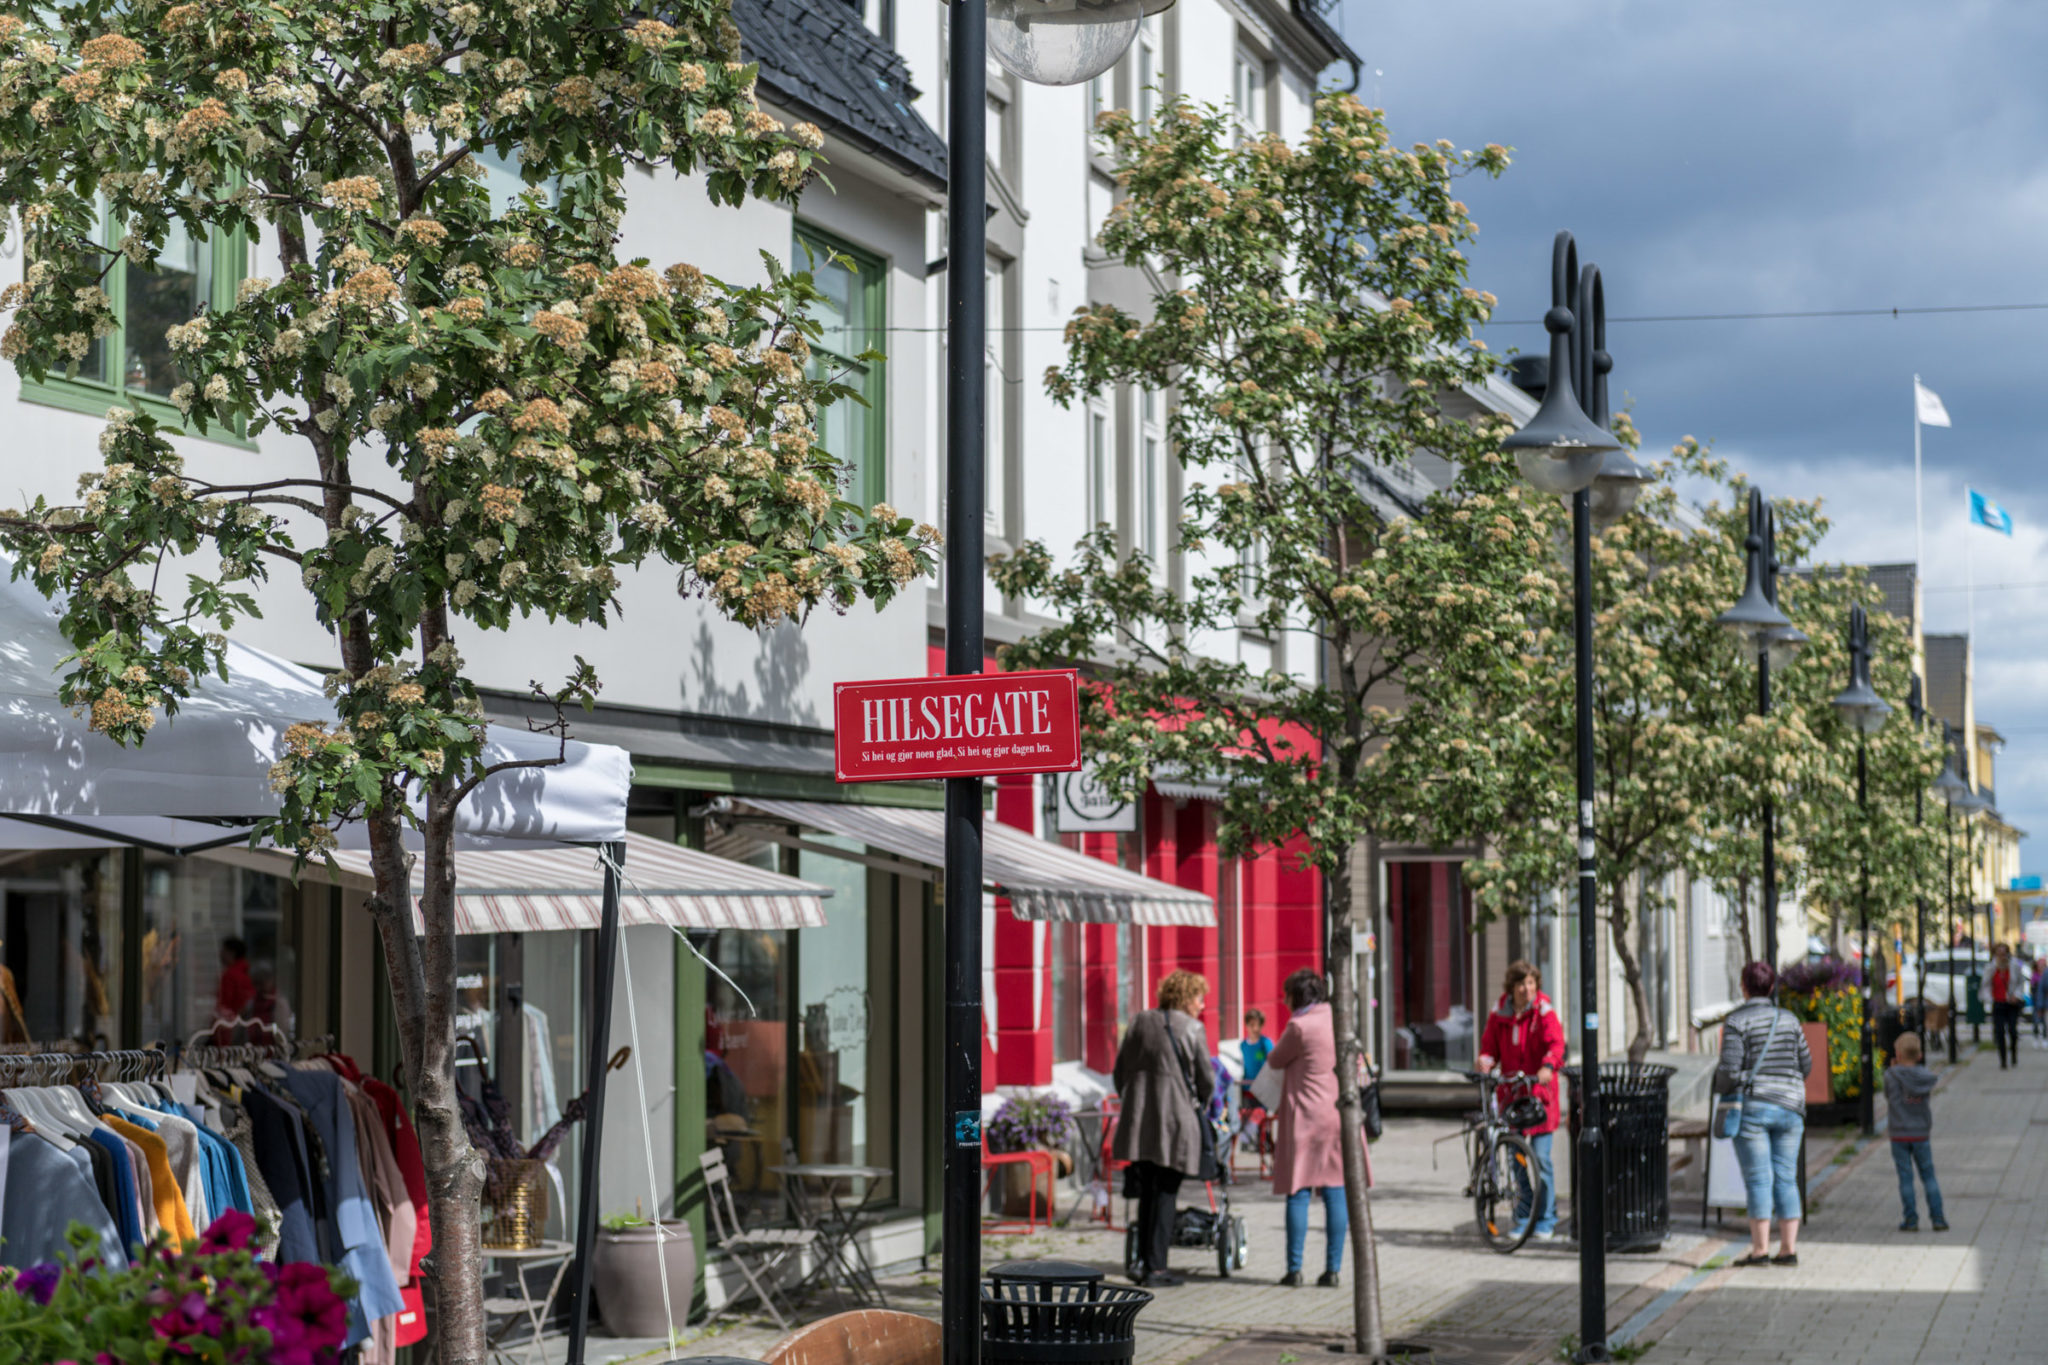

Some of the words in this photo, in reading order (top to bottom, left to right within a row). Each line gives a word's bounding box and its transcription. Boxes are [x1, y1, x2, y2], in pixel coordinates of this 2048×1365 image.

[860, 689, 1053, 744] HILSEGATE
[862, 751, 870, 762] Si
[872, 750, 885, 761] hei
[886, 752, 896, 763] og
[915, 751, 934, 759] noen
[957, 746, 965, 757] Si
[967, 746, 980, 757] hei
[982, 748, 992, 759] og
[1011, 743, 1035, 757] dagen
[1037, 742, 1053, 753] bra.
